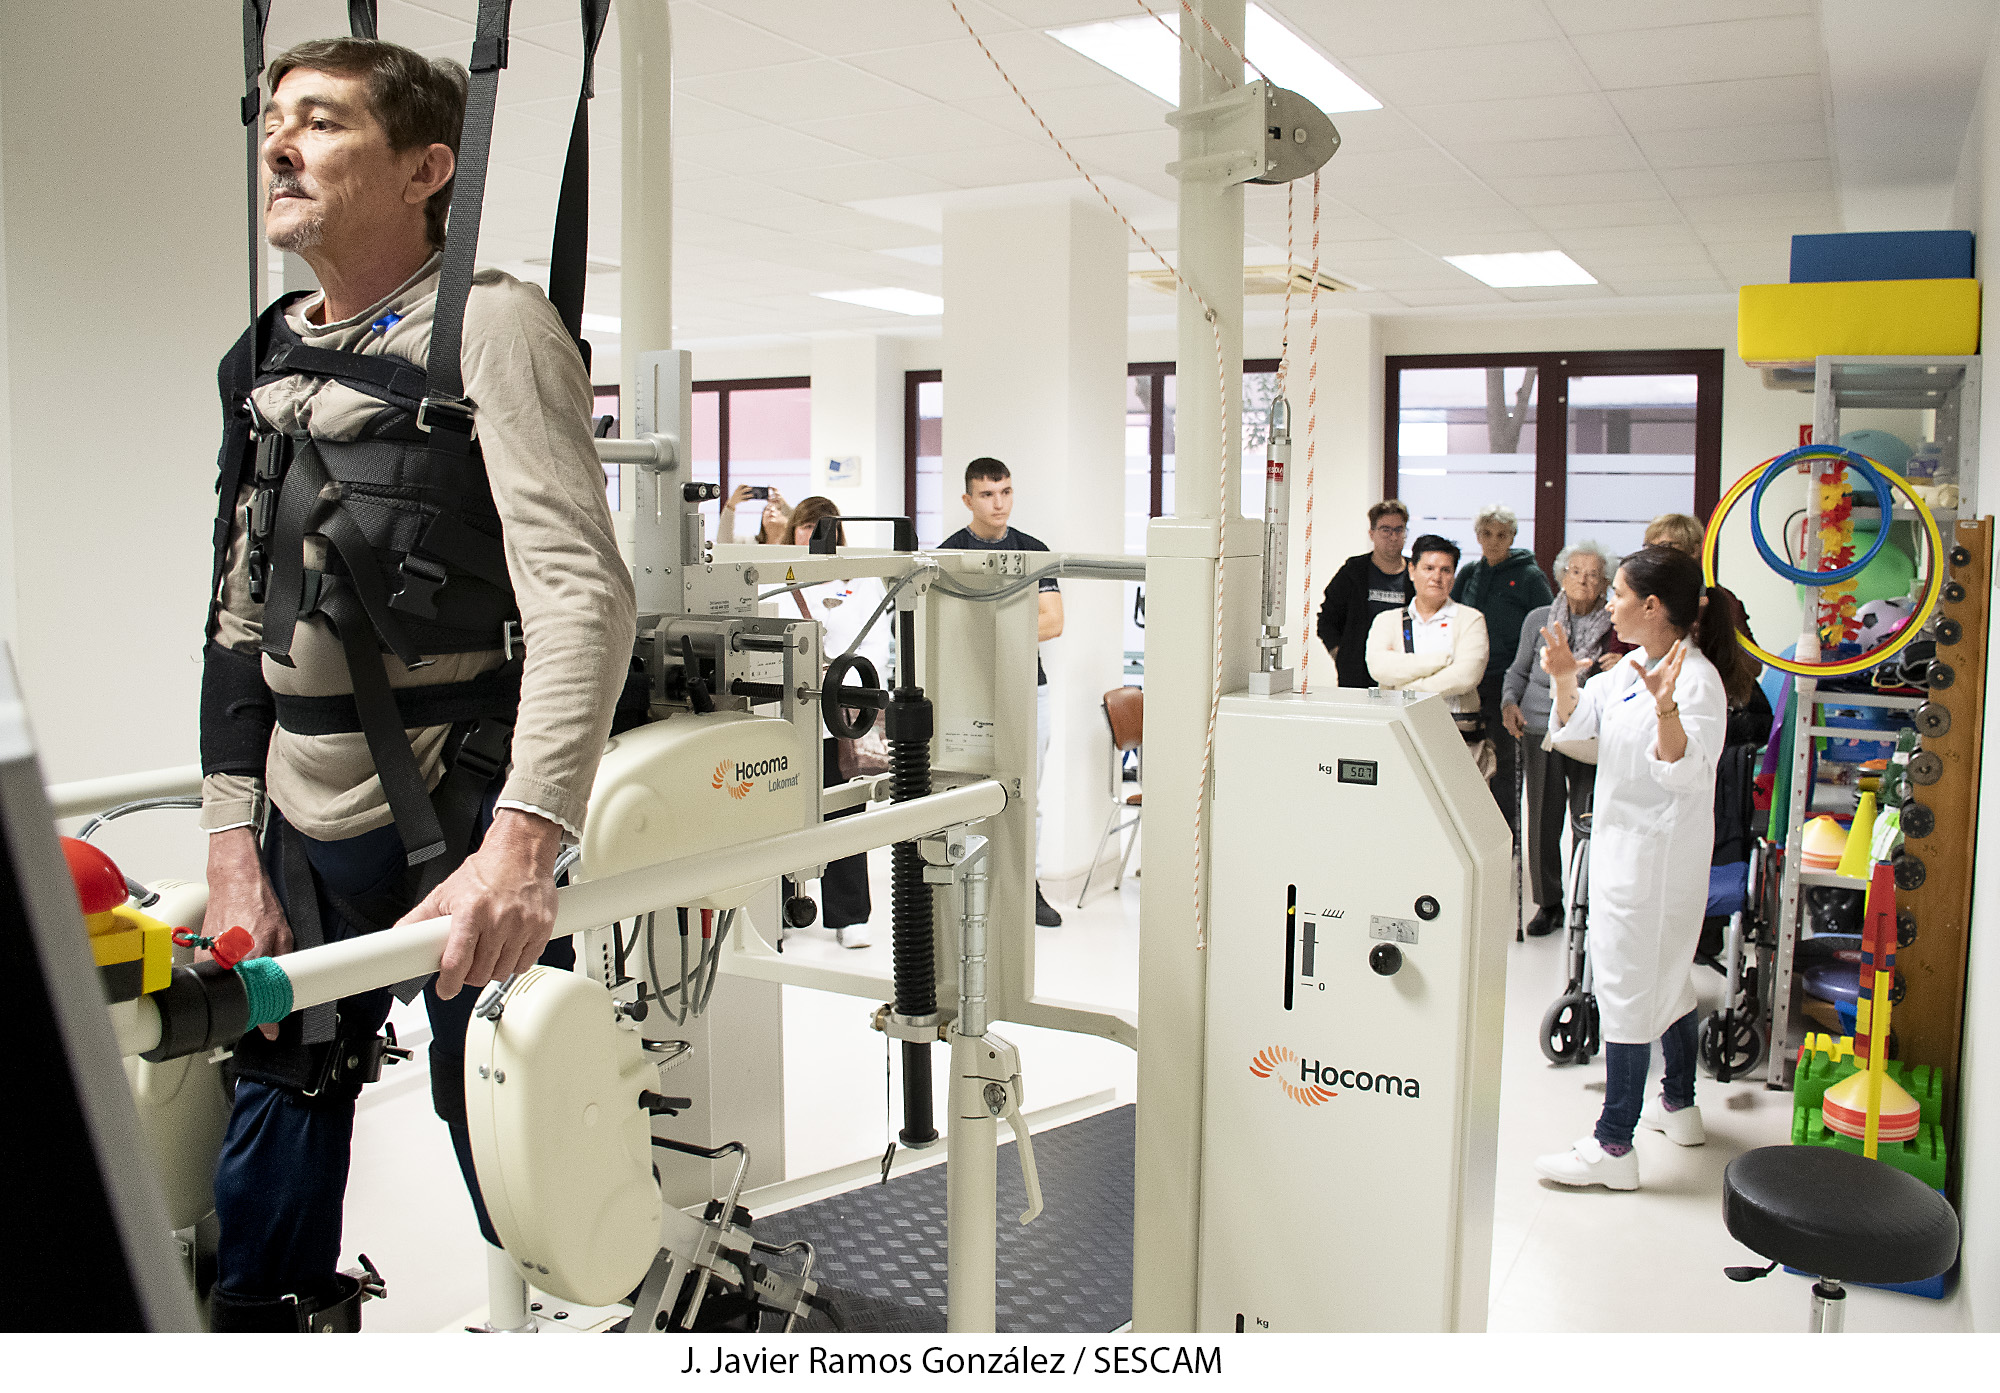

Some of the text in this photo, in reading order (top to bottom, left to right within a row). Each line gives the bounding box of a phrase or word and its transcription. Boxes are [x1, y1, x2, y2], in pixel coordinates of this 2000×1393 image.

[736, 756, 788, 781] Hocoma
[1318, 763, 1332, 774] kg
[1350, 766, 1372, 778] 50.7
[768, 774, 798, 792] Lokomat
[1301, 1058, 1420, 1098] Hocoma
[1256, 1317, 1269, 1329] kg
